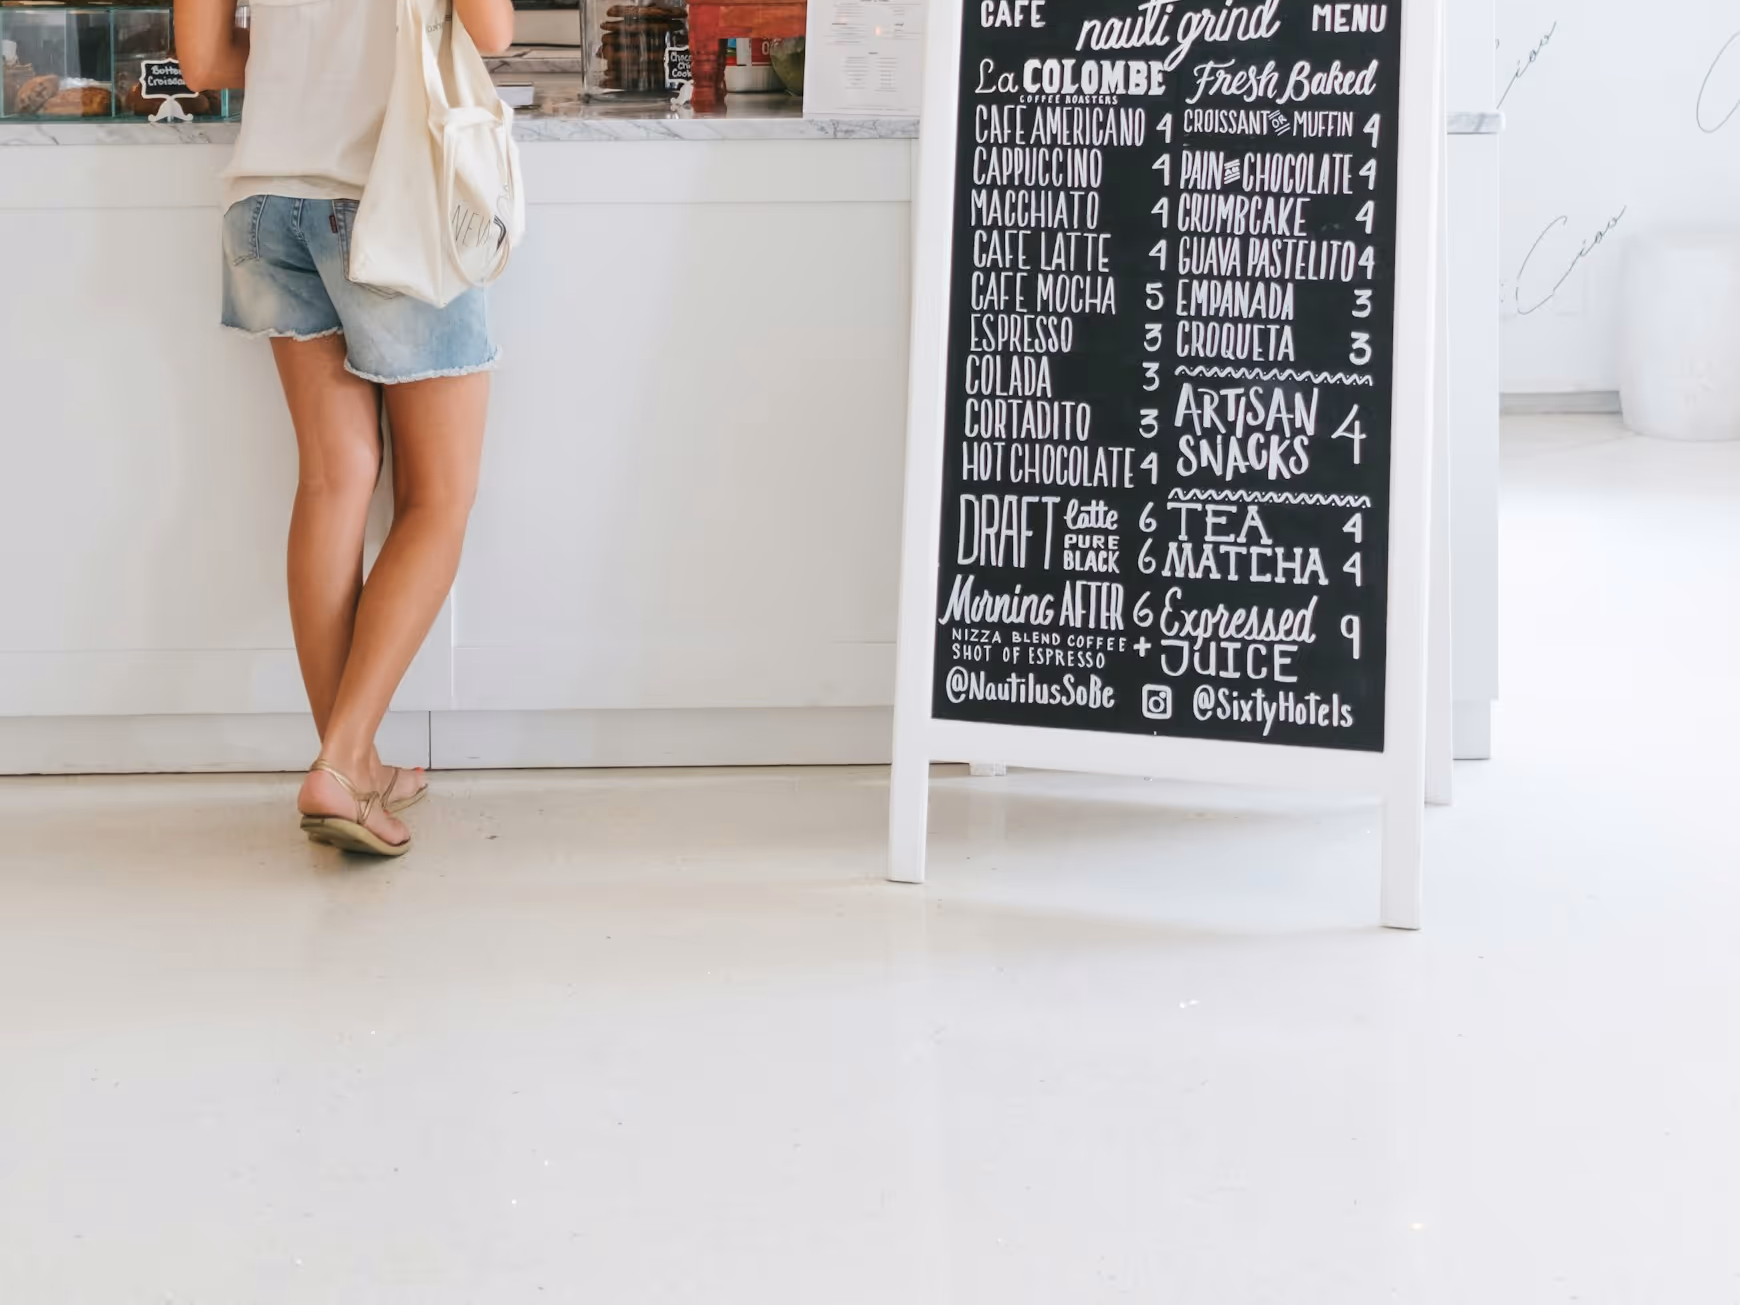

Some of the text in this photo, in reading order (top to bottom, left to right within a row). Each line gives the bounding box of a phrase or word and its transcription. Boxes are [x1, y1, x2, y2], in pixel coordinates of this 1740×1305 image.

[1311, 3, 1388, 34] MENU
[974, 57, 1167, 96] La COLOMBE
[1184, 58, 1379, 105] Fresh Baked
[1019, 94, 1118, 106] COFFEE ROASTERS
[975, 104, 1173, 147] CAFE AMERICANO 4
[1183, 108, 1271, 136] CROISSANT
[1292, 110, 1354, 139] MUFFIN
[1362, 112, 1381, 149] 4
[972, 145, 1171, 189] CAPPUCCINO 4
[1179, 149, 1225, 191] PAIN
[1241, 151, 1354, 195] CHOCOLATE
[1358, 157, 1377, 191] 4
[970, 188, 1169, 230] MACCHIATO 4
[1177, 192, 1375, 237] CRUMBCAKE 4
[973, 229, 1167, 273] CAFE LATTE 4
[1178, 235, 1376, 283] GUAVA PASTELITO 4
[1515, 205, 1627, 315] Ciao
[971, 270, 1165, 315] CAFE MOCHA 5
[1175, 278, 1373, 321] EMPANADA 3
[970, 313, 1163, 354] ESPRESSO 3
[1176, 319, 1373, 366] CROQUETA 3
[965, 354, 1160, 399] COLADA 3
[964, 397, 1159, 442] CORTADITO 3
[1174, 382, 1319, 439] ARTISAN
[1176, 430, 1310, 482] SNACKS
[1330, 403, 1367, 465] 4
[962, 440, 1158, 489] HOT CHOCOLATE 4
[957, 493, 1158, 570] DRAFT latte 6
[1166, 499, 1363, 546] TEA 4
[1063, 533, 1157, 575] PURE BLACK 6
[1161, 541, 1362, 588] MATCHA 4
[937, 573, 1154, 631] Morning AFTER 6
[1159, 586, 1361, 660] Expressed 9
[951, 627, 1002, 644] NIZZA
[1011, 631, 1061, 646] BLEND
[1066, 634, 1127, 652] COFFEE
[951, 642, 1106, 669] SHOT OF ESPRESSO
[1160, 638, 1299, 683] JUICE
[945, 665, 1115, 709] @NautilusSoBe
[1192, 684, 1354, 737] @SixtyHotels
